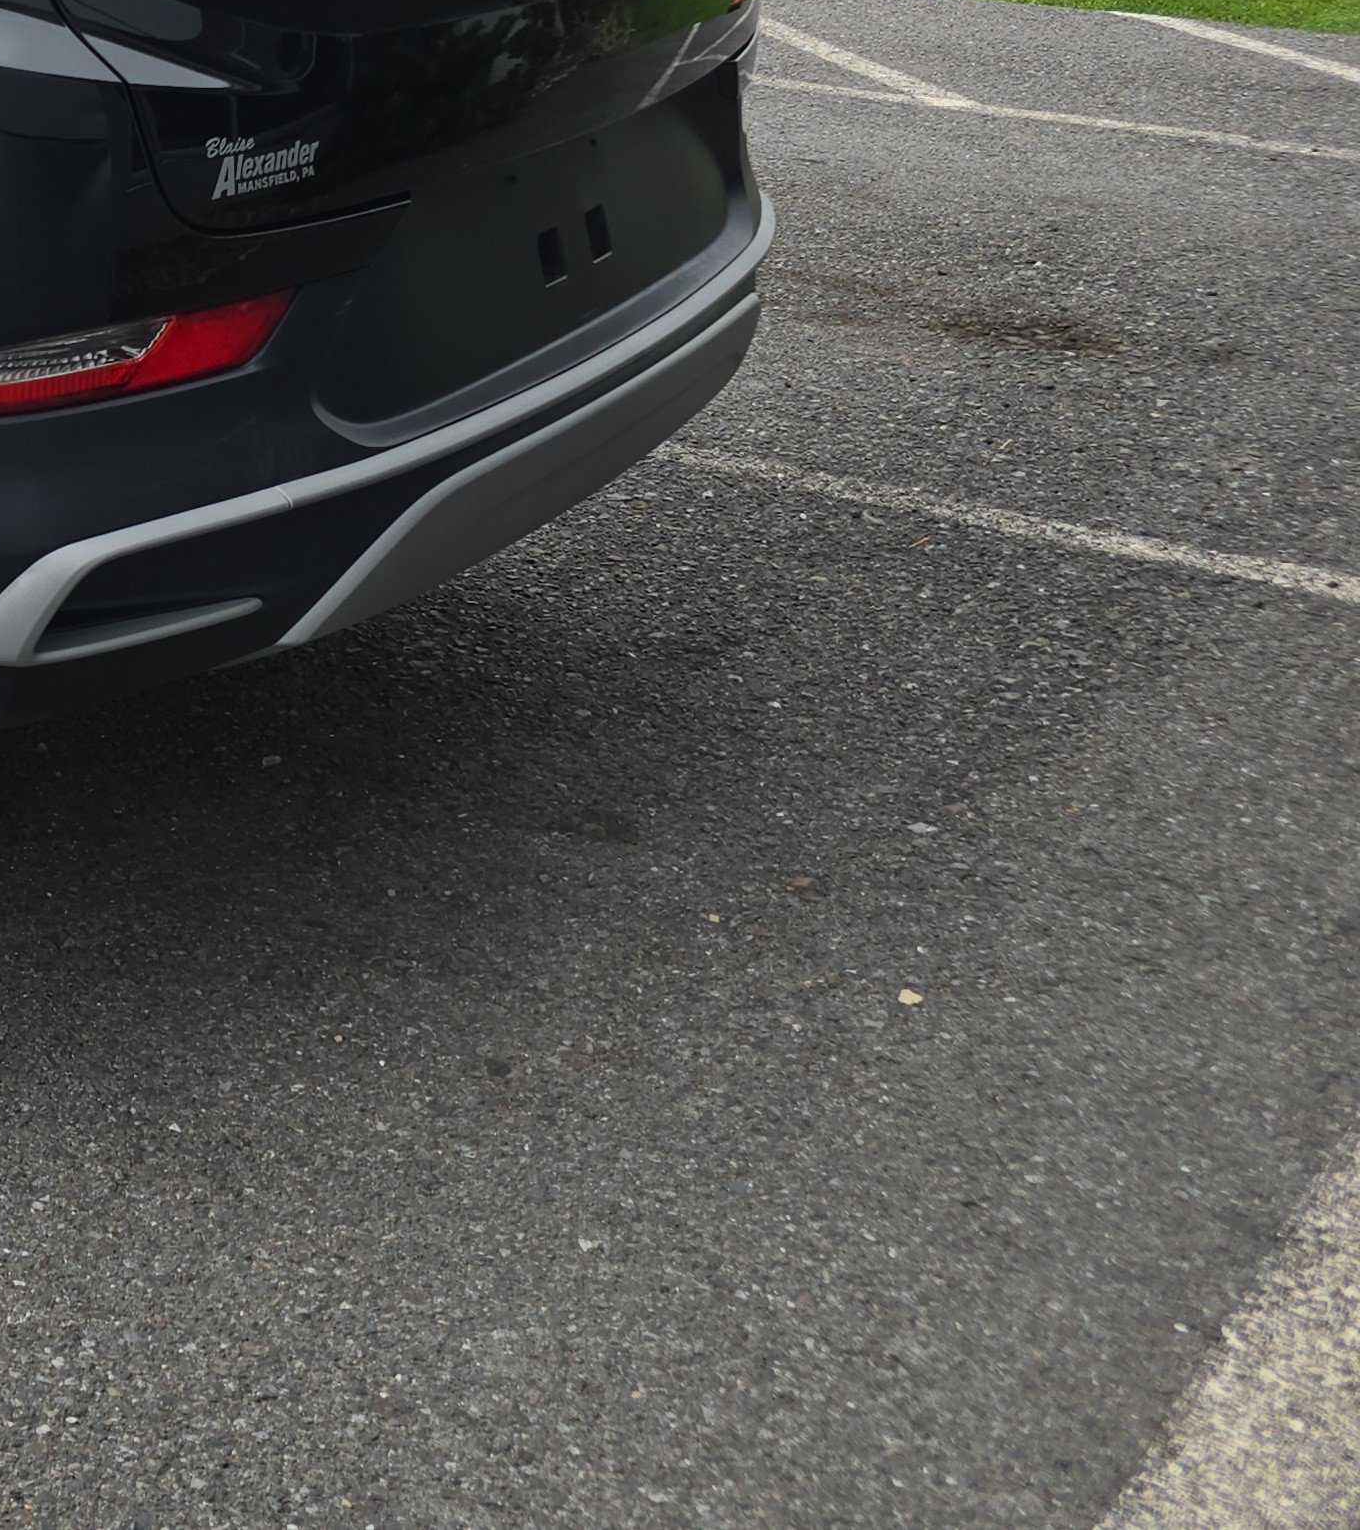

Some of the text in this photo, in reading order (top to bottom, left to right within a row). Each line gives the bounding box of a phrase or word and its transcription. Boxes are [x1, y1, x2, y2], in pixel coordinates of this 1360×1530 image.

[205, 137, 255, 159] Blaise
[211, 140, 320, 201] Alexander
[237, 165, 316, 195] MANSFIELD, PA
